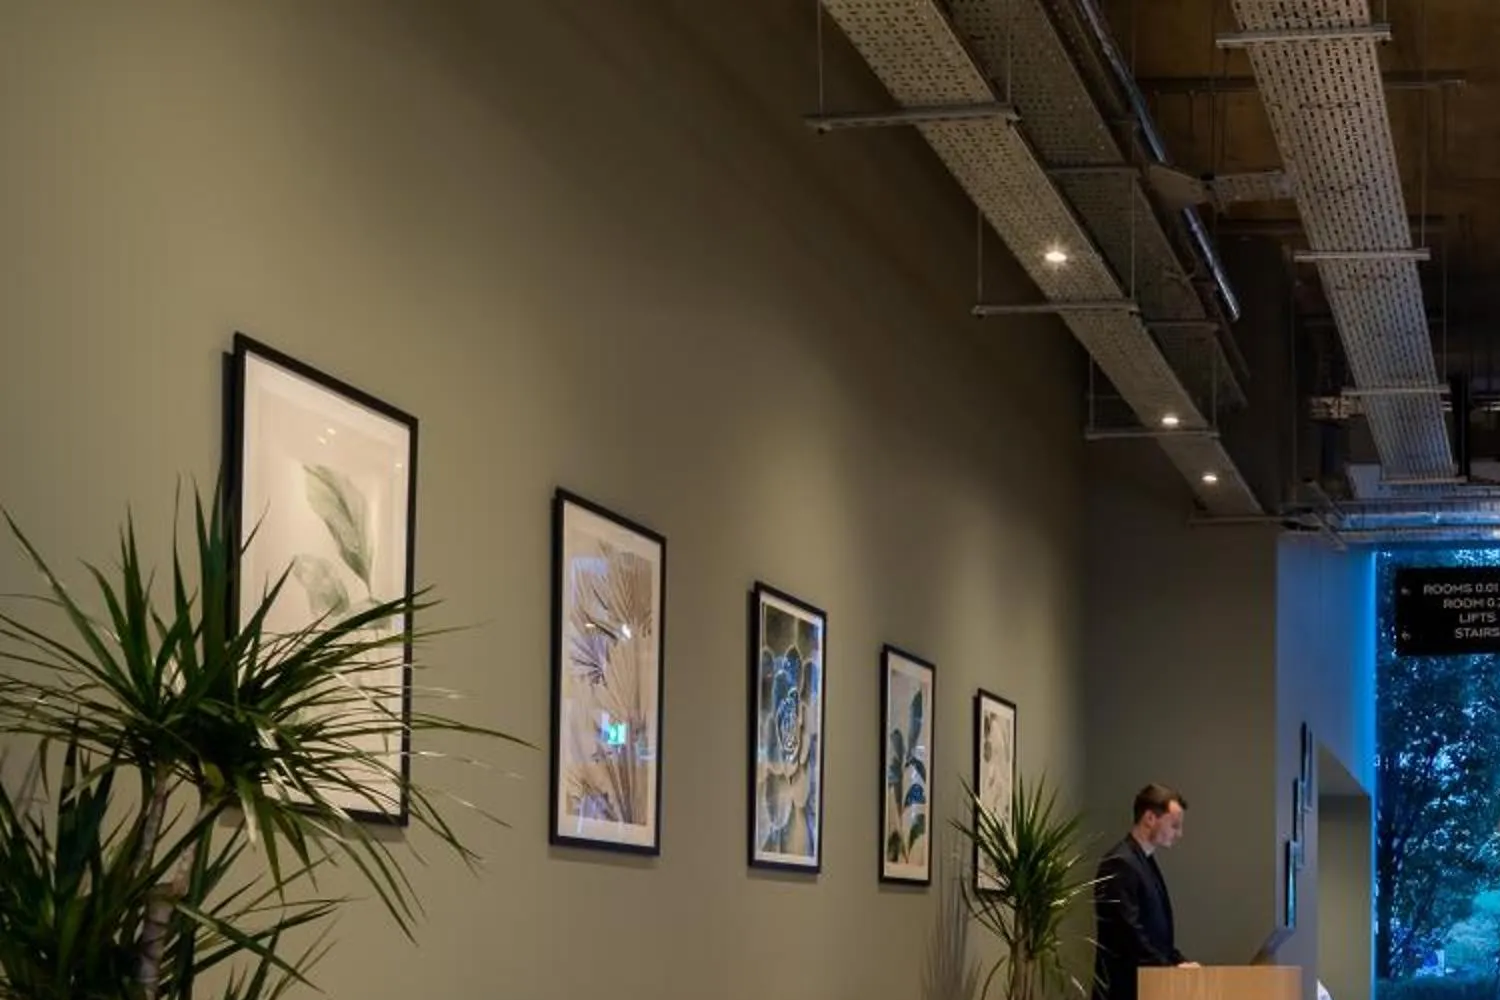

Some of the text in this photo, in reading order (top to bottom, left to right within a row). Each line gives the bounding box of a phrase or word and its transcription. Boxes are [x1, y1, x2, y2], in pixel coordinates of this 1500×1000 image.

[1423, 583, 1473, 595] ROOMS
[1443, 597, 1484, 609] ROOM
[1459, 612, 1497, 624] LIFTS
[1454, 627, 1500, 639] STAIRS
